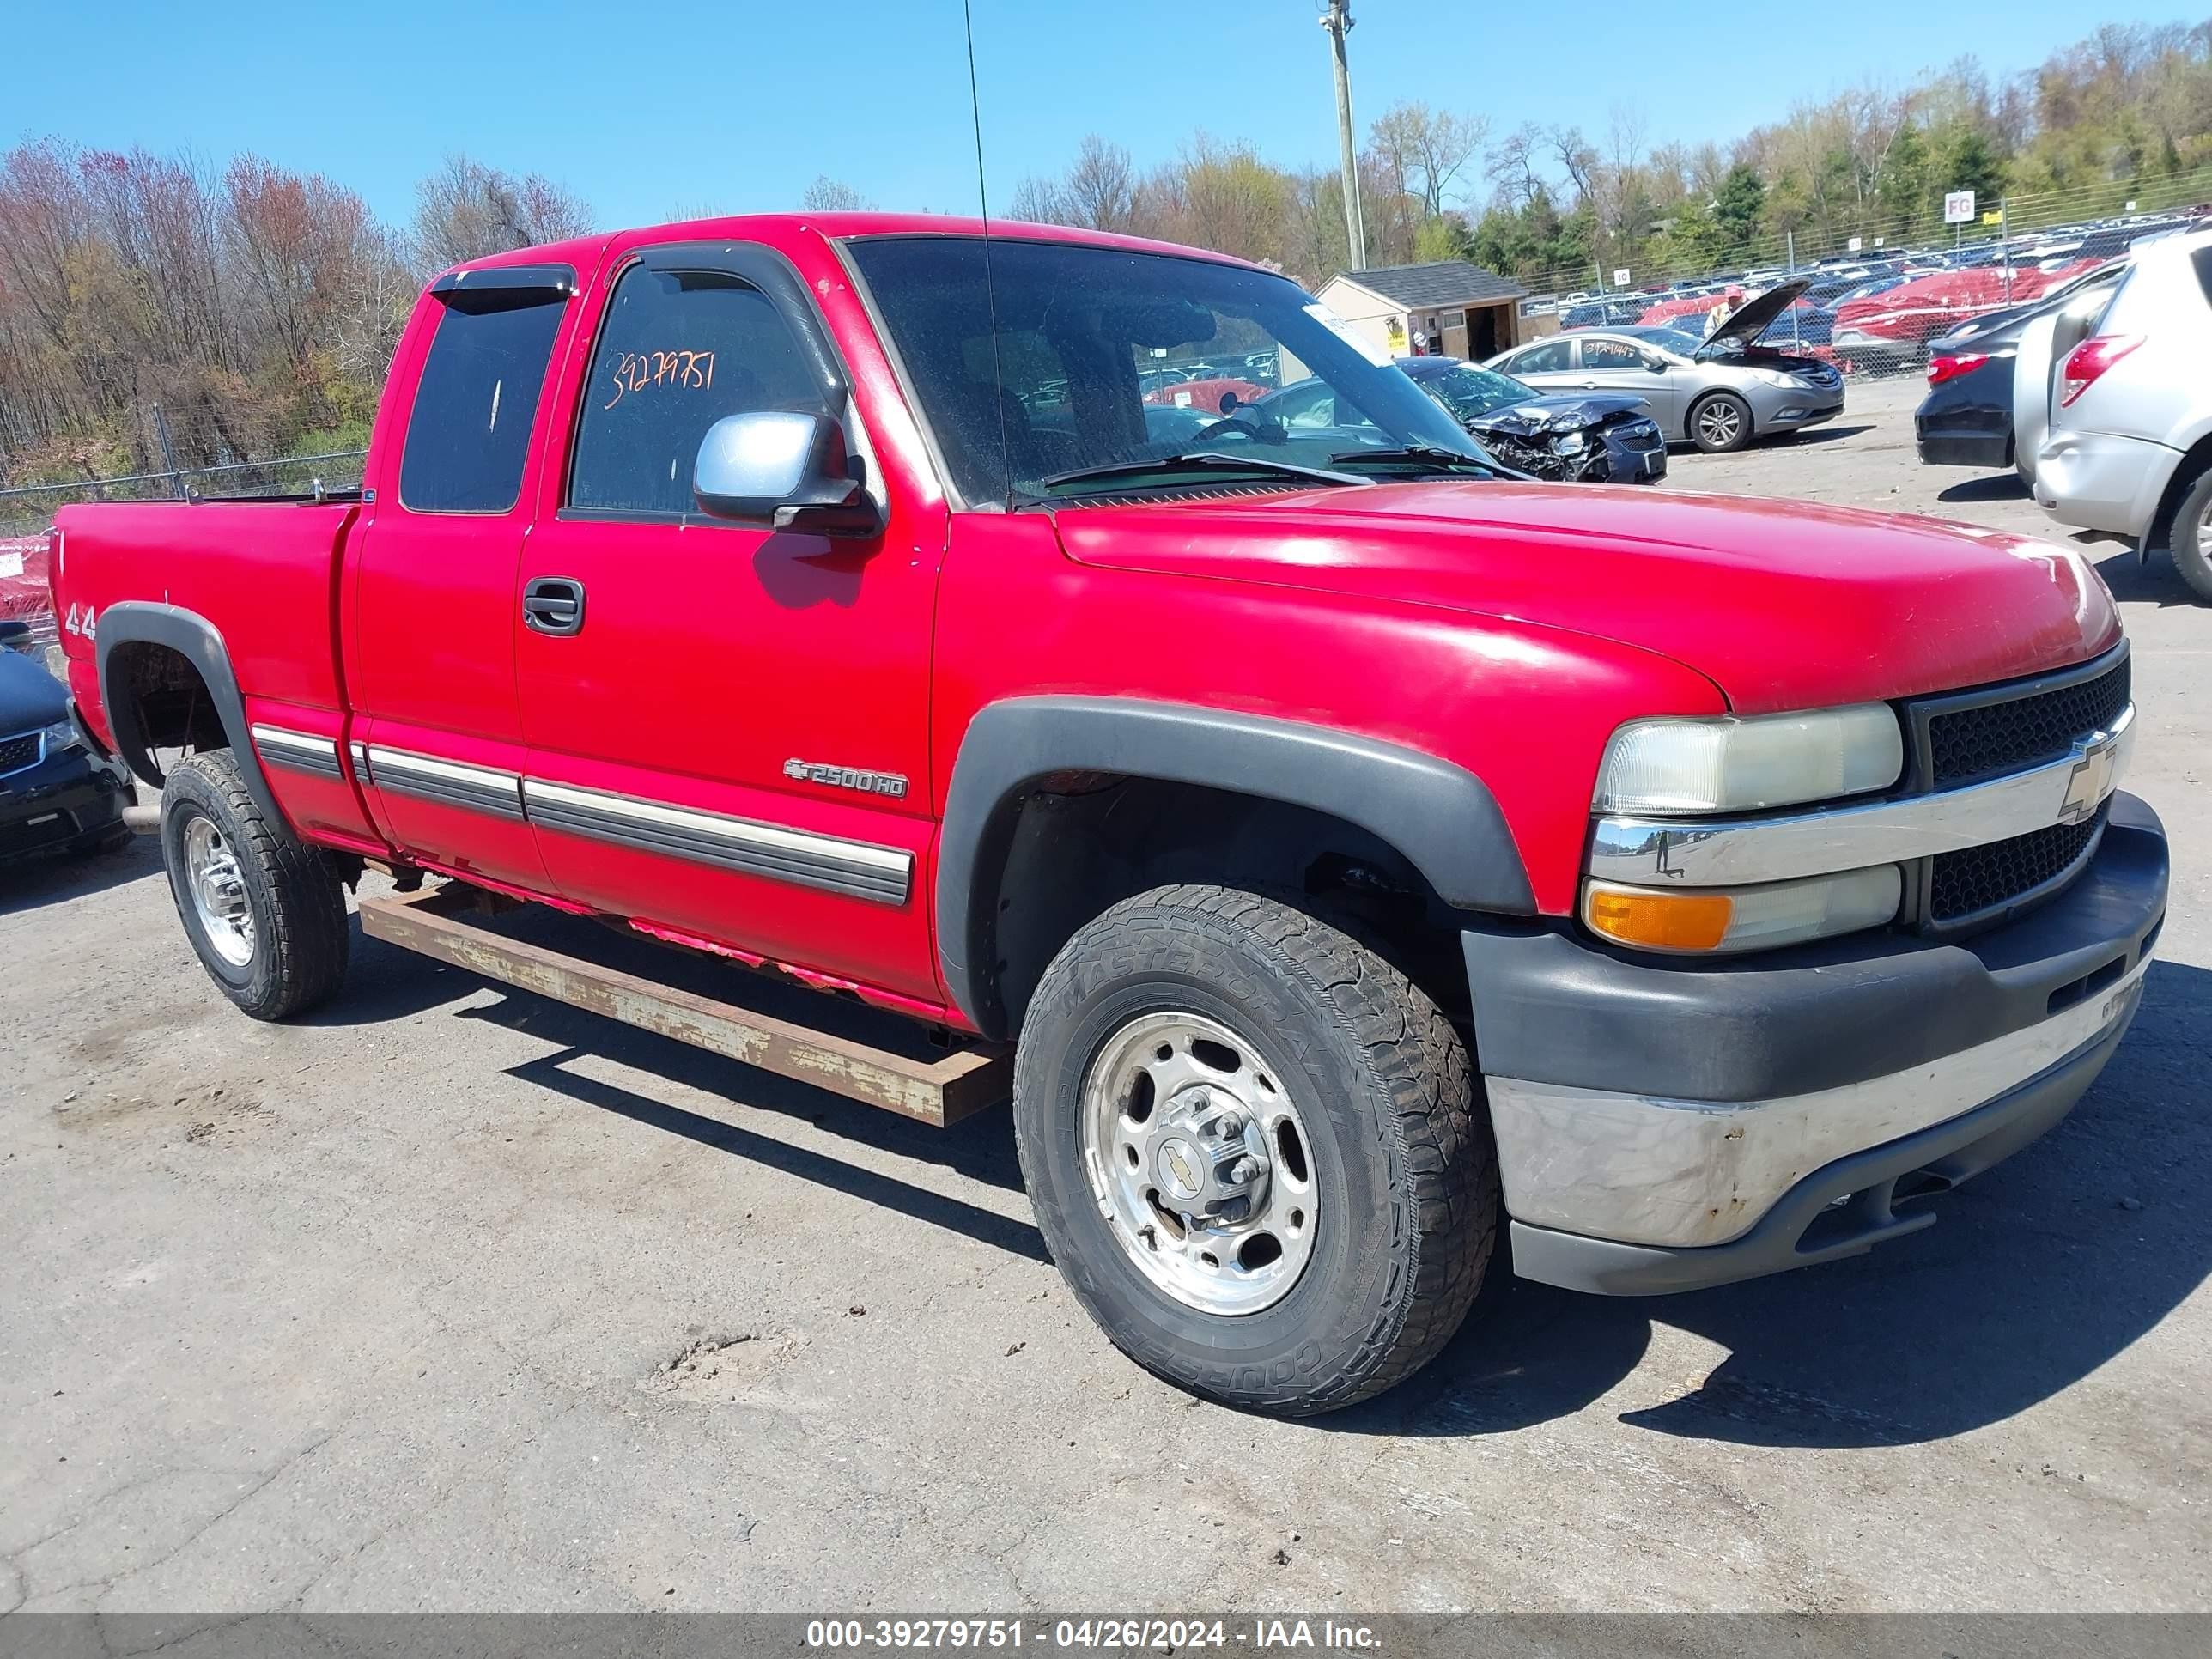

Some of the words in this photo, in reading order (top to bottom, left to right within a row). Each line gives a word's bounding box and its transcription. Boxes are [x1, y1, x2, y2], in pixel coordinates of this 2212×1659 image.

[1948, 198, 1971, 215] FG
[1618, 273, 1627, 283] 10
[604, 349, 715, 410] 39279751
[812, 767, 872, 791] 2500
[876, 777, 902, 795] HD
